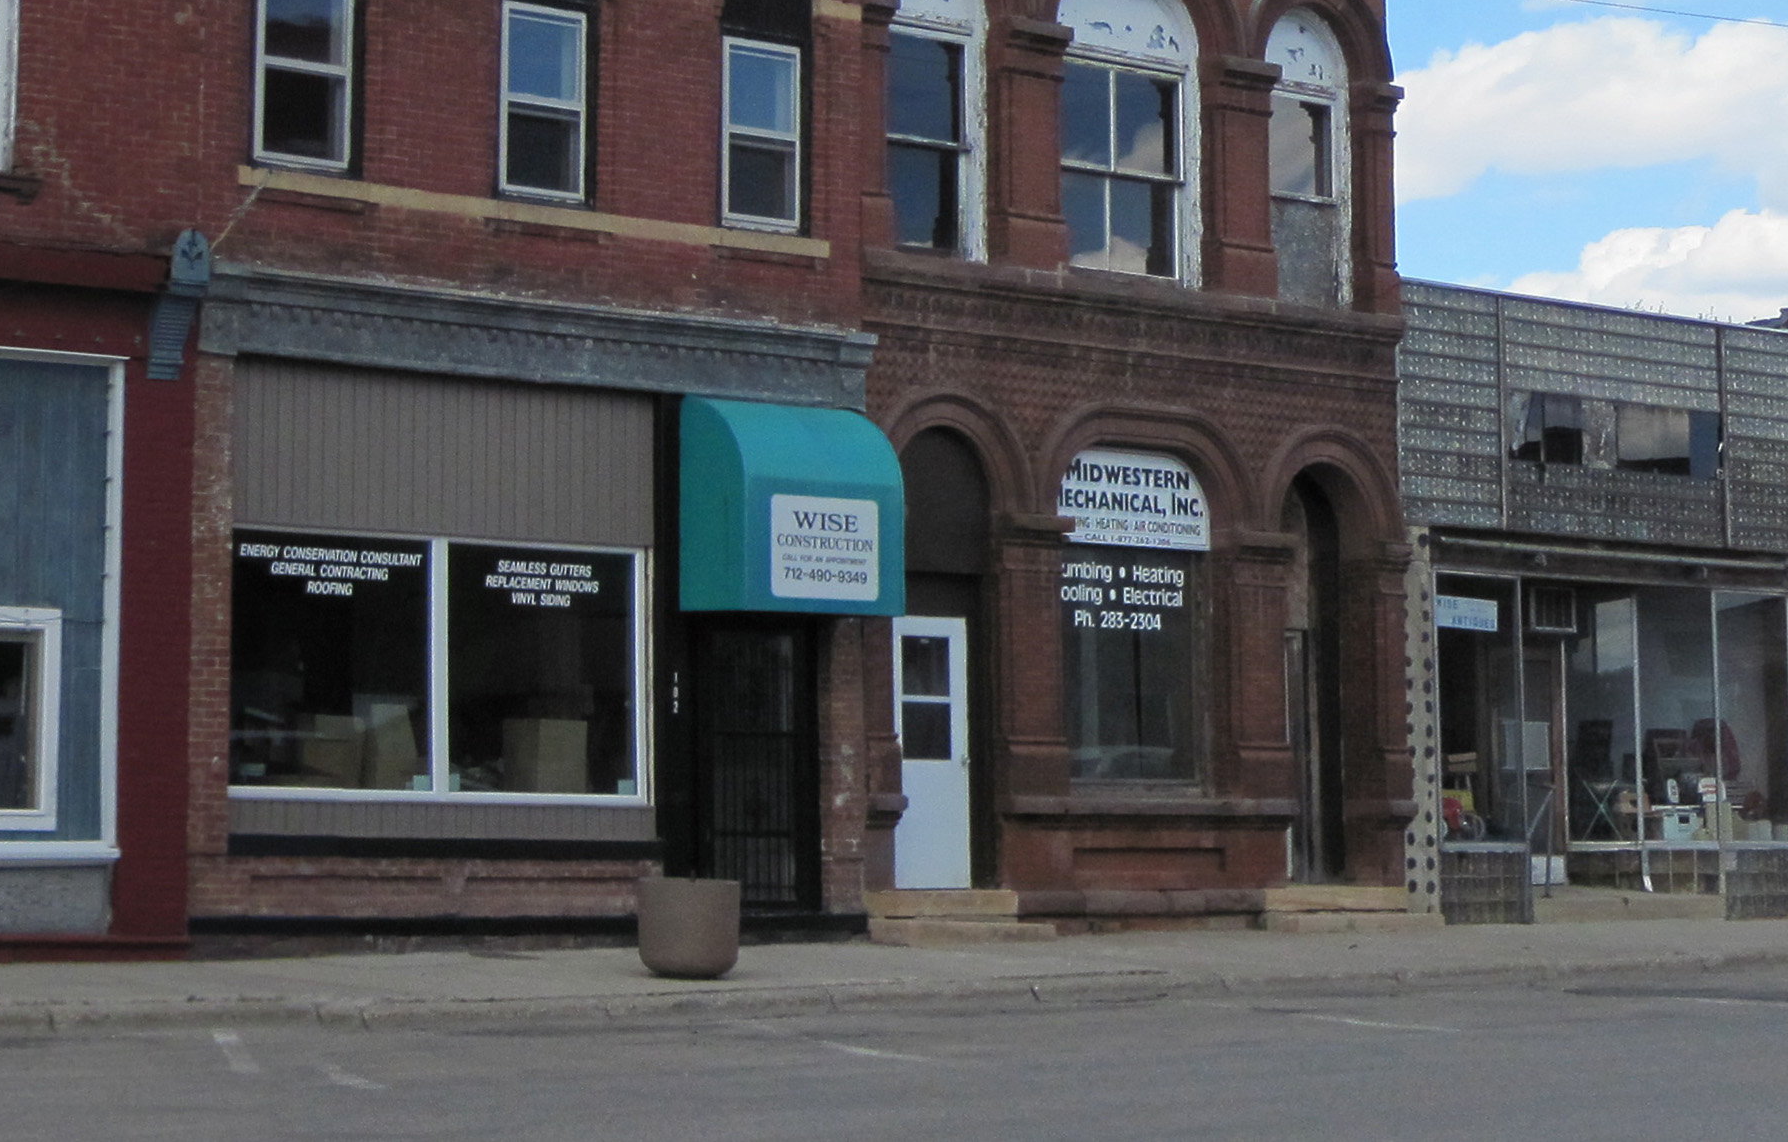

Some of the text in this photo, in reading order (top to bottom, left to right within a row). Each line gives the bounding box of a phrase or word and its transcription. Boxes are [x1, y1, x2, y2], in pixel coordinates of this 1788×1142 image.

[1065, 458, 1190, 490] MIDWESTERN
[1058, 485, 1167, 518] ECHANICAL,
[793, 510, 859, 533] WISE
[1095, 517, 1129, 531] HEATING
[1147, 521, 1201, 537] CONDITIONING
[777, 533, 874, 552] CONSTRUCTION
[1084, 533, 1107, 542] CALL
[239, 543, 423, 567] ENERGY CONSERVATION CONSULTANT
[271, 562, 389, 581] GENERAL CONTRACTING
[497, 559, 592, 578] SEAMLESS GUTTERS
[783, 566, 868, 585] 712-490-9349
[1061, 561, 1185, 587] umbing Heating
[306, 581, 354, 596] ROOFING
[485, 575, 600, 594] REPLACEMENT WINDOWS
[512, 592, 571, 608] VINYL SIDING
[1060, 584, 1183, 607] ooling Electrical
[1074, 609, 1162, 631] Ph. 283-2304
